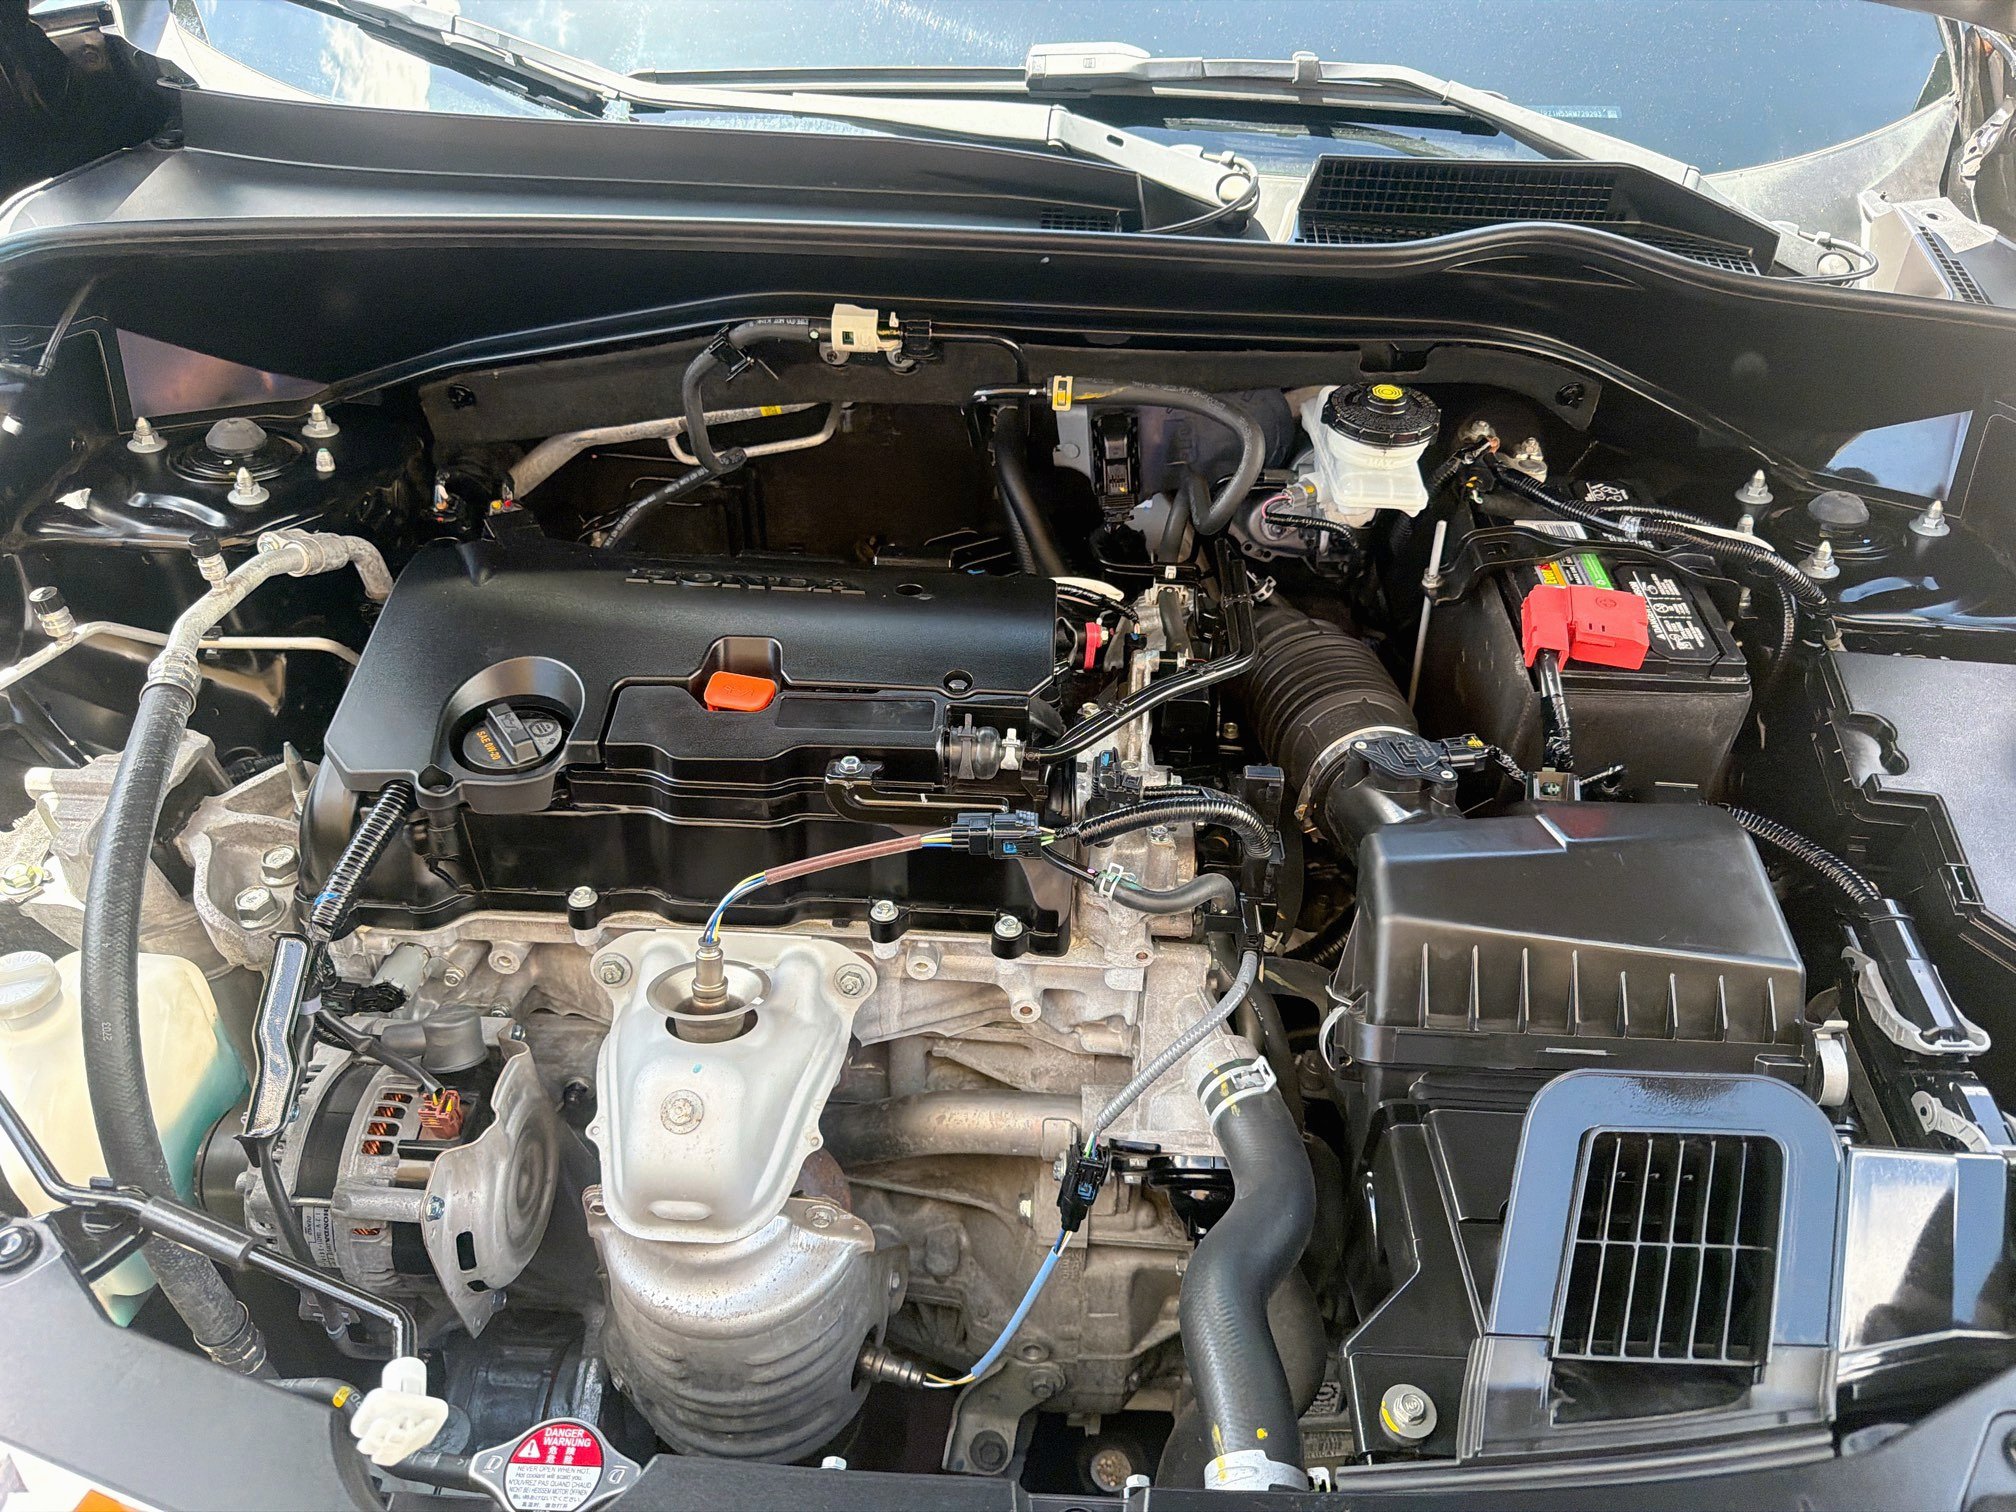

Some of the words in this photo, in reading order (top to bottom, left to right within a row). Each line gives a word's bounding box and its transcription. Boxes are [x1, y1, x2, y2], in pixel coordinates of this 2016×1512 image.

[476, 730, 490, 745] SAE
[485, 742, 501, 760] 0W-20
[102, 1022, 112, 1042] 2703
[544, 1428, 584, 1437] DANGER
[543, 1438, 592, 1448] WARNUNG
